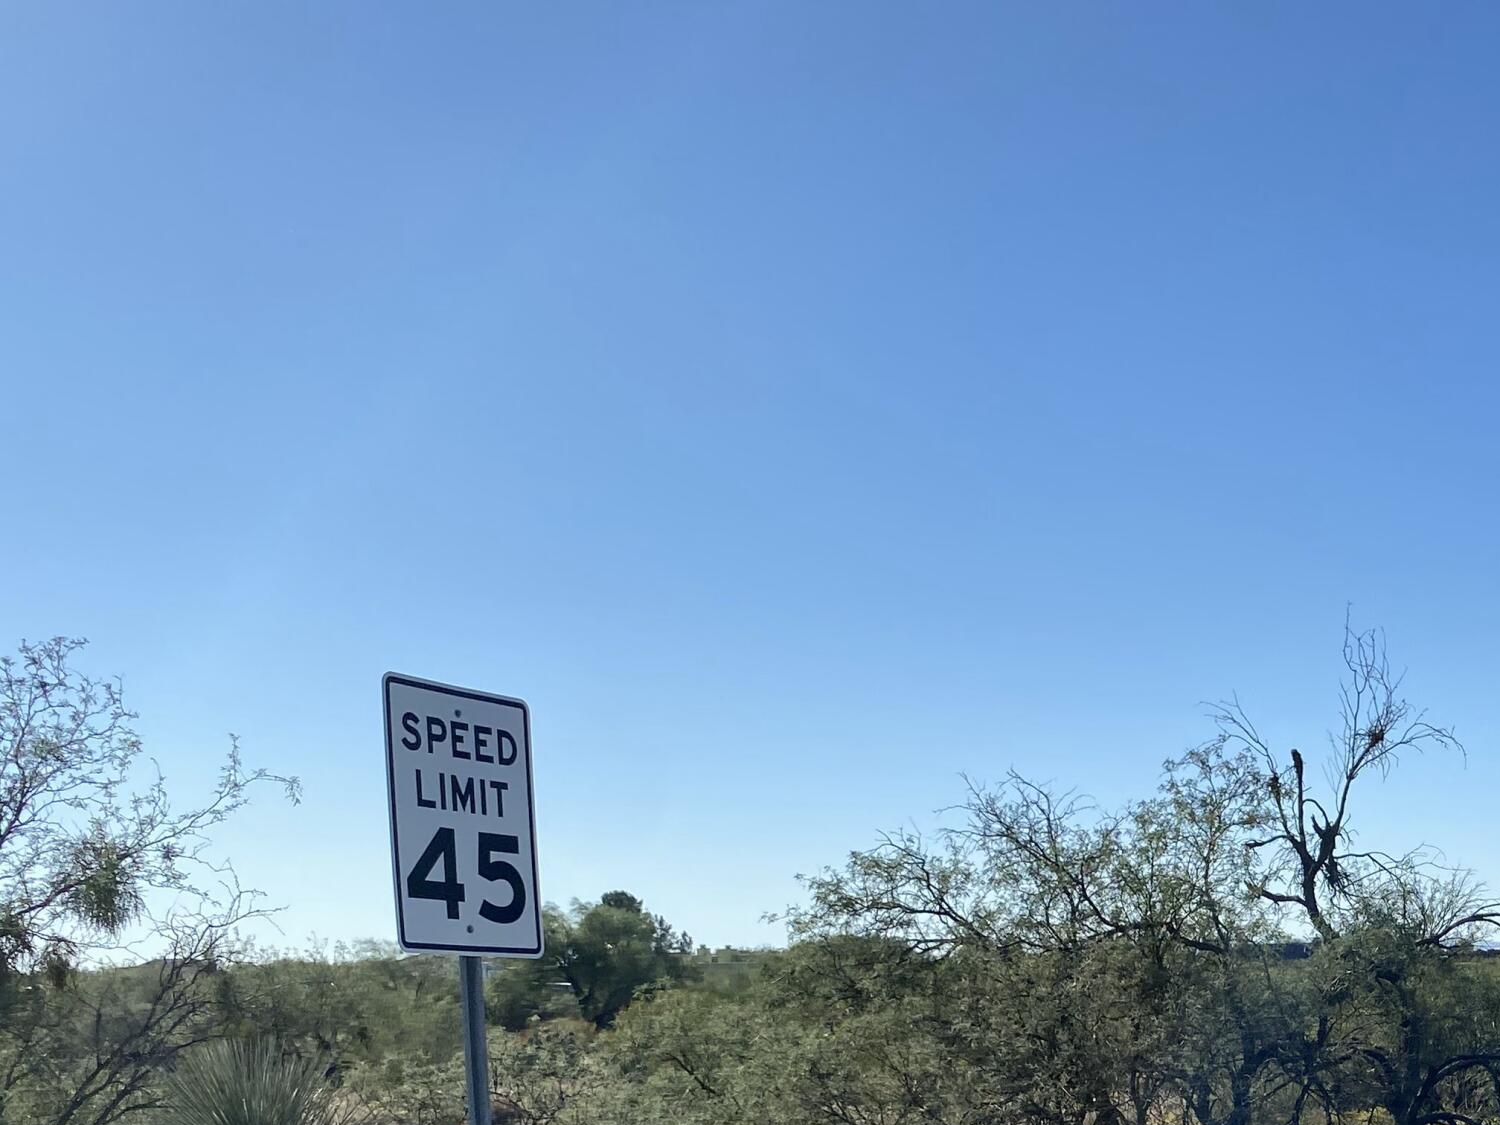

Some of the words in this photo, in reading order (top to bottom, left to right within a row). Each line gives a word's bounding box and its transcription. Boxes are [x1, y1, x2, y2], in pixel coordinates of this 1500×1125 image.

[401, 711, 518, 766] SPEED
[415, 768, 509, 818] LIMIT
[406, 826, 526, 924] 45
